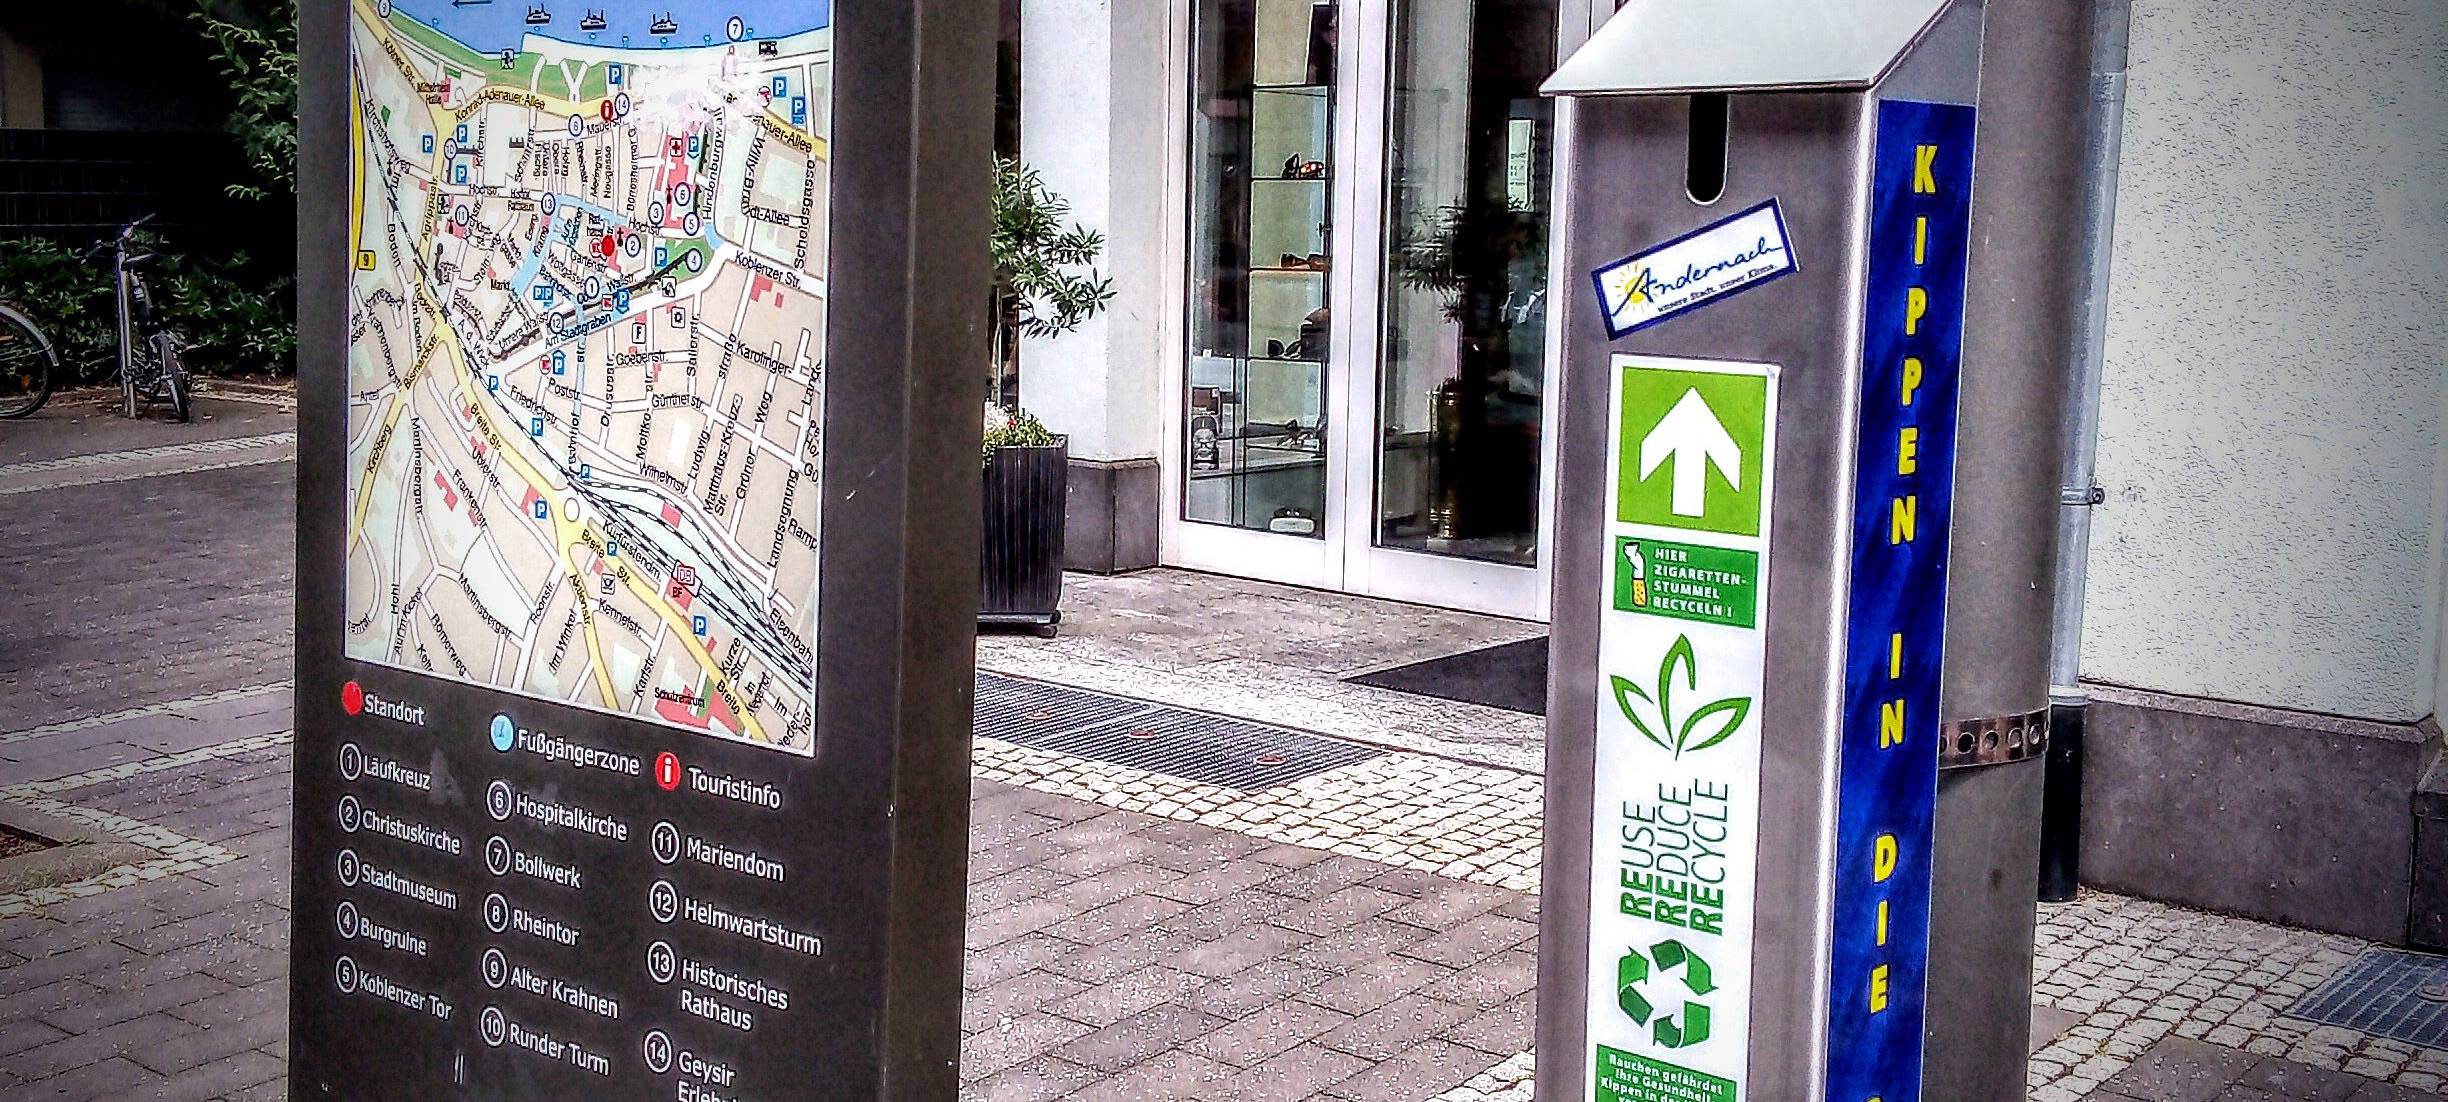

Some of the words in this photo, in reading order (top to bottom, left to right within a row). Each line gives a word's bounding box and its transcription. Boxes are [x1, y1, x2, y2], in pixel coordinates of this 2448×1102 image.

[735, 251, 784, 282] Koblenzer
[784, 272, 801, 289] Str.
[1611, 237, 1783, 317] Andernach
[545, 335, 559, 349] Am
[1890, 145, 1937, 545] KIPPEN
[1654, 548, 1688, 563] HIER
[1654, 564, 1746, 586] ZIGARETTEN-
[458, 572, 513, 641] Martinsbergstr.
[1653, 580, 1720, 600] STUMMEL
[1653, 597, 1722, 617] RECYCELN
[719, 638, 741, 676] Kurze
[364, 694, 425, 727] Standort
[775, 697, 788, 716] Im
[1880, 633, 1905, 749] IN
[364, 755, 431, 790] Läufkreuz
[518, 729, 640, 776] Fußgängerzone
[688, 767, 780, 809] Touristinfo
[362, 810, 460, 855] Christuskirche
[516, 794, 628, 841] Hospitalkirche
[515, 851, 581, 889] Bollwerk
[687, 837, 784, 882] Mariendom
[1620, 801, 1655, 919] REUSE
[1655, 783, 1692, 927] REDUCE
[1689, 778, 1728, 936] RECYCLE
[361, 863, 457, 910] Stadtmuseum
[360, 917, 427, 956] Burgruine
[513, 909, 580, 946] Rheintor
[684, 898, 822, 956] Helmwartsturm
[1868, 834, 1898, 1013] DIE
[360, 970, 426, 1010] Koblenzer
[428, 995, 452, 1020] Tor
[510, 967, 549, 995] Alter
[552, 979, 618, 1019] Krahnen
[682, 959, 789, 1010] Historisches
[681, 989, 752, 1031] Rathaus
[510, 1024, 565, 1059] Runder
[568, 1043, 609, 1076] Turm
[679, 1051, 736, 1087] Geysir
[1600, 1077, 1642, 1097] Kippen
[1645, 1089, 1657, 1102] in
[1609, 1053, 1659, 1077] Rauchen
[1662, 1072, 1723, 1095] gefährdet
[1615, 1068, 1639, 1084] Ihre
[1642, 1077, 1711, 1102] Gesundheit
